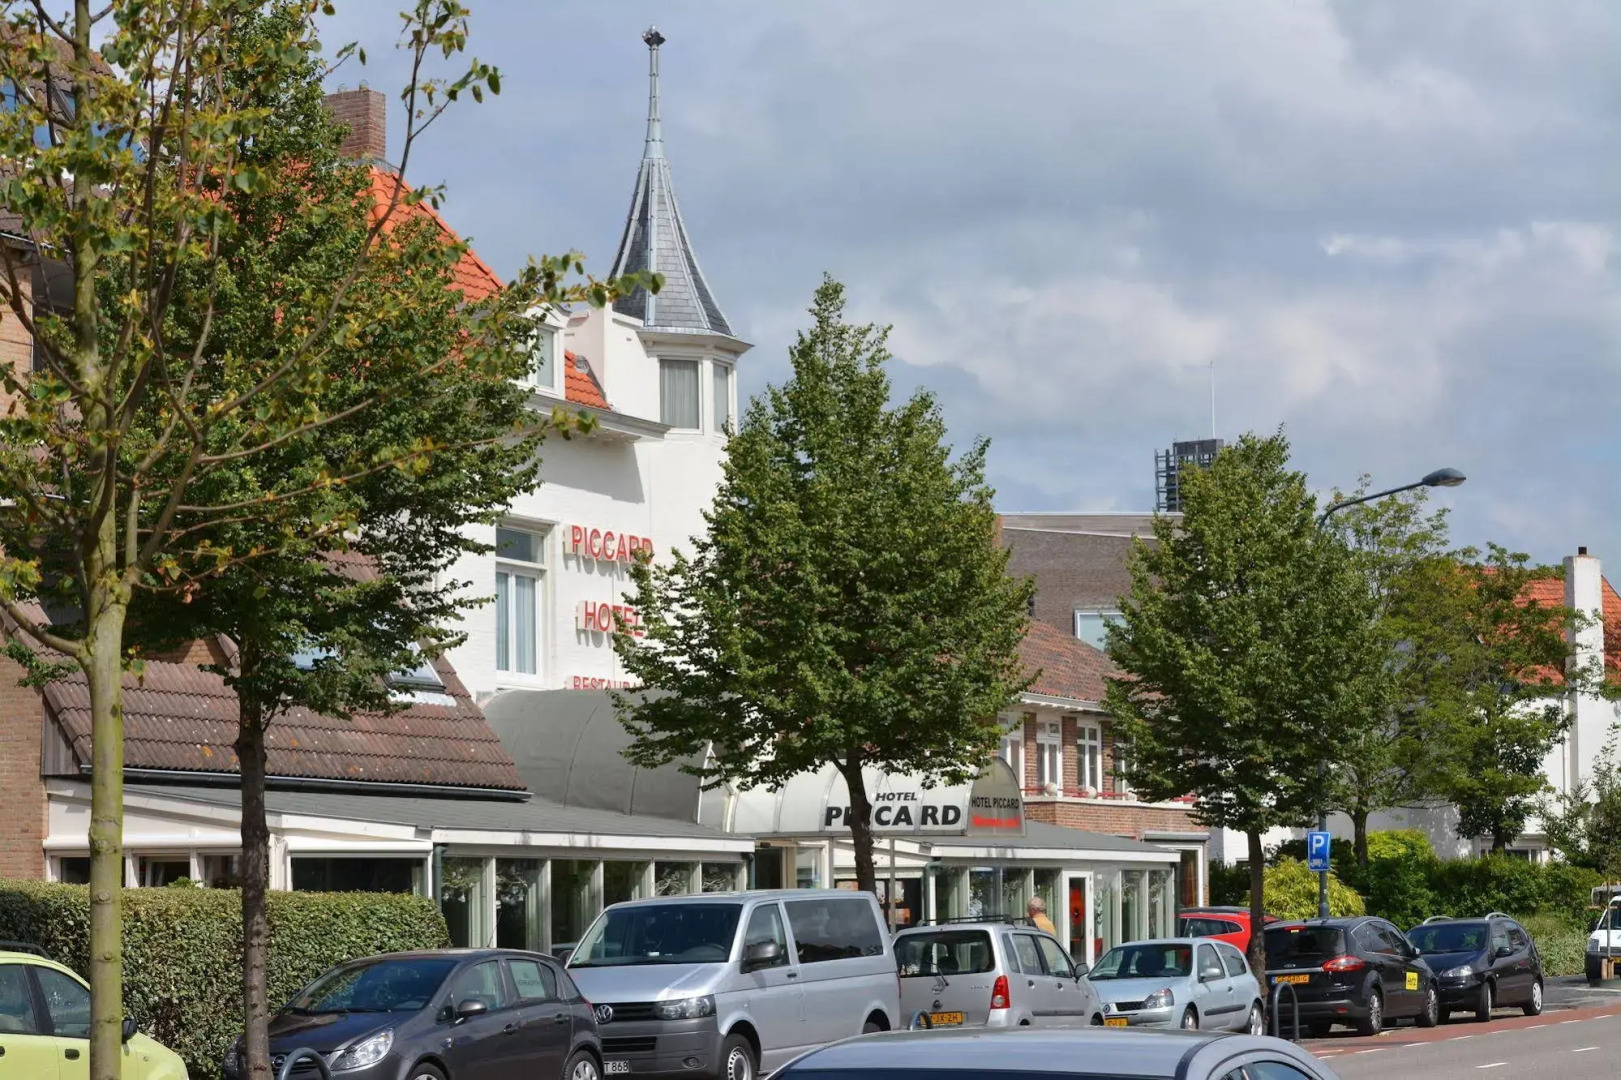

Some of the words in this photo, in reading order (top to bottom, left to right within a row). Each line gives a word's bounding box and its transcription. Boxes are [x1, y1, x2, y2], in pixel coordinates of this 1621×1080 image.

[571, 524, 653, 564] PICCARD
[584, 600, 644, 637] HOTEL
[875, 792, 918, 802] HOTEL
[971, 796, 991, 808] HOTEL
[993, 797, 1020, 809] PICCARD
[824, 805, 961, 826] PICARD
[1312, 834, 1325, 855] P
